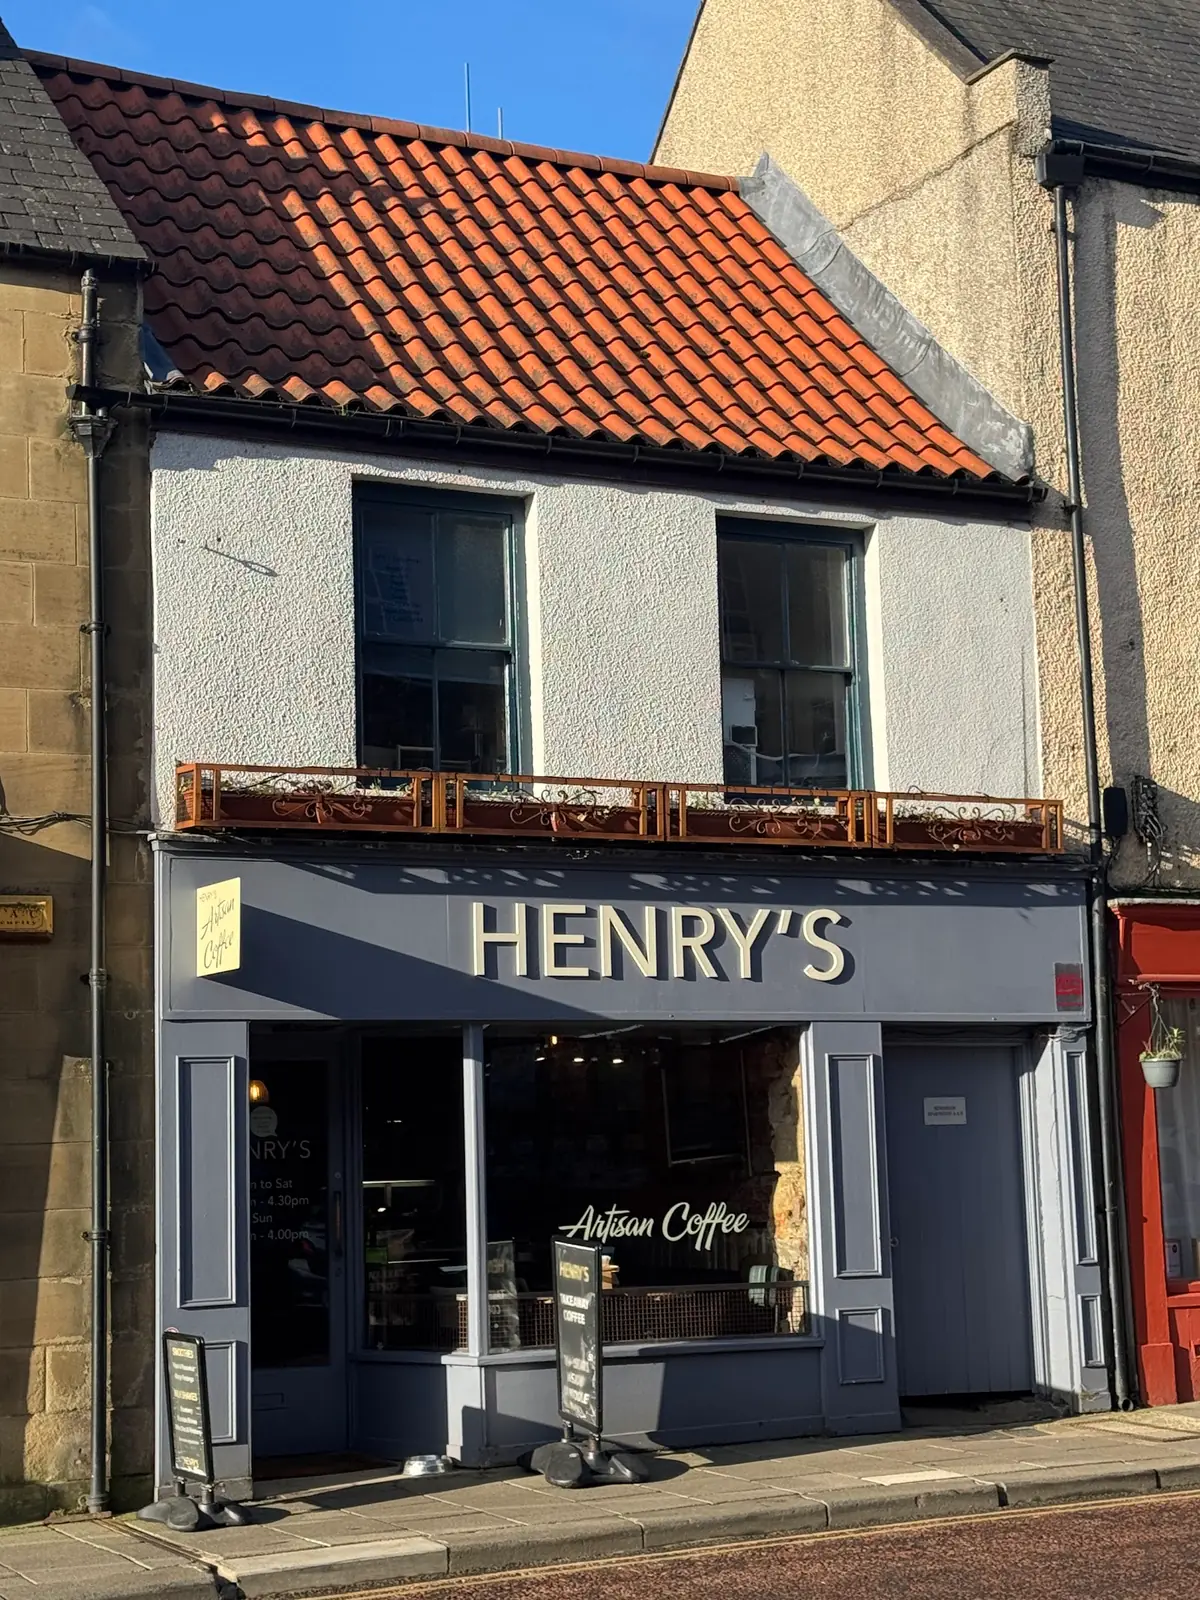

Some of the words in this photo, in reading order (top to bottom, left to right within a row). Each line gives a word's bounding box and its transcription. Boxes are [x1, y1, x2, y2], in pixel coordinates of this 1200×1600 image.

[201, 898, 235, 940] Artisan
[204, 929, 234, 969] Coffee
[472, 901, 845, 981] HENRY'S
[250, 1140, 311, 1160] NRY'S
[260, 1179, 272, 1189] to
[275, 1178, 293, 1189] Sat
[267, 1195, 309, 1209] 4.30pm
[252, 1213, 273, 1223] Sun
[558, 1203, 655, 1244] Artisan
[661, 1202, 750, 1251] Coffee
[267, 1229, 309, 1242] 4.00pm
[563, 1309, 586, 1325] COFFEE
